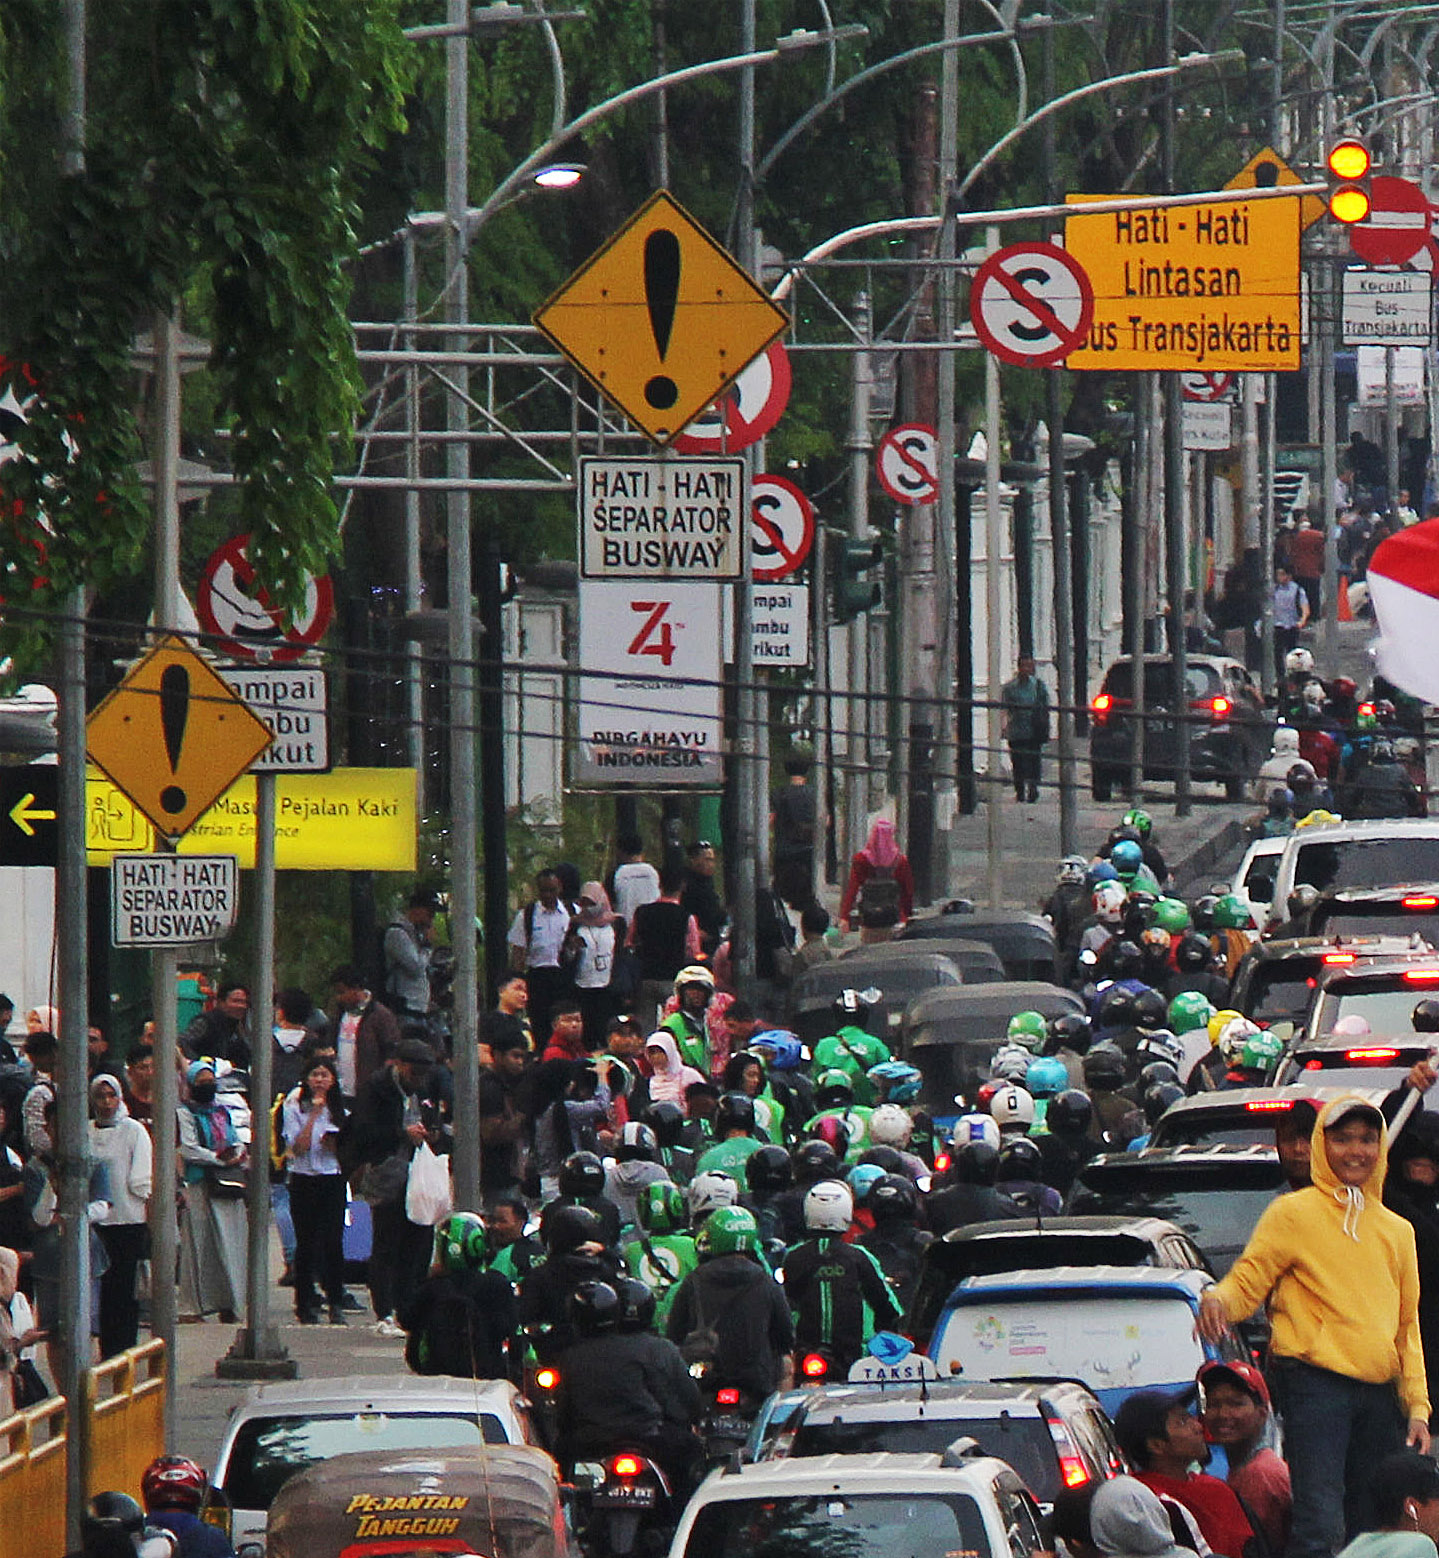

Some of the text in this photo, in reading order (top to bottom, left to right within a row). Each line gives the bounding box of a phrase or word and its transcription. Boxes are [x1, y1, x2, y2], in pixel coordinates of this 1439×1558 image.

[1115, 210, 1171, 246] Hati
[1195, 208, 1249, 245] Hati
[1123, 261, 1240, 298] Lintasan
[1375, 300, 1398, 315] Bus
[1129, 317, 1291, 361] Transjakarta
[593, 472, 649, 499] HATI
[675, 472, 732, 499] HATI
[593, 506, 732, 533] SEPARATOR
[604, 541, 725, 567] BUSWAY
[628, 601, 676, 666] 74
[593, 731, 707, 746] DIRGAHAYU
[598, 753, 704, 767] INDONESIA
[281, 799, 350, 821] Pejalan
[358, 797, 398, 816] Kaki
[123, 864, 165, 885] HATI
[184, 863, 226, 884] HATI
[122, 889, 228, 911] SEPARATOR
[131, 914, 215, 938] BUSWAY
[866, 1367, 922, 1379] TAKSI
[347, 1493, 469, 1513] PEJANTAN
[356, 1515, 461, 1537] TANGGUH
